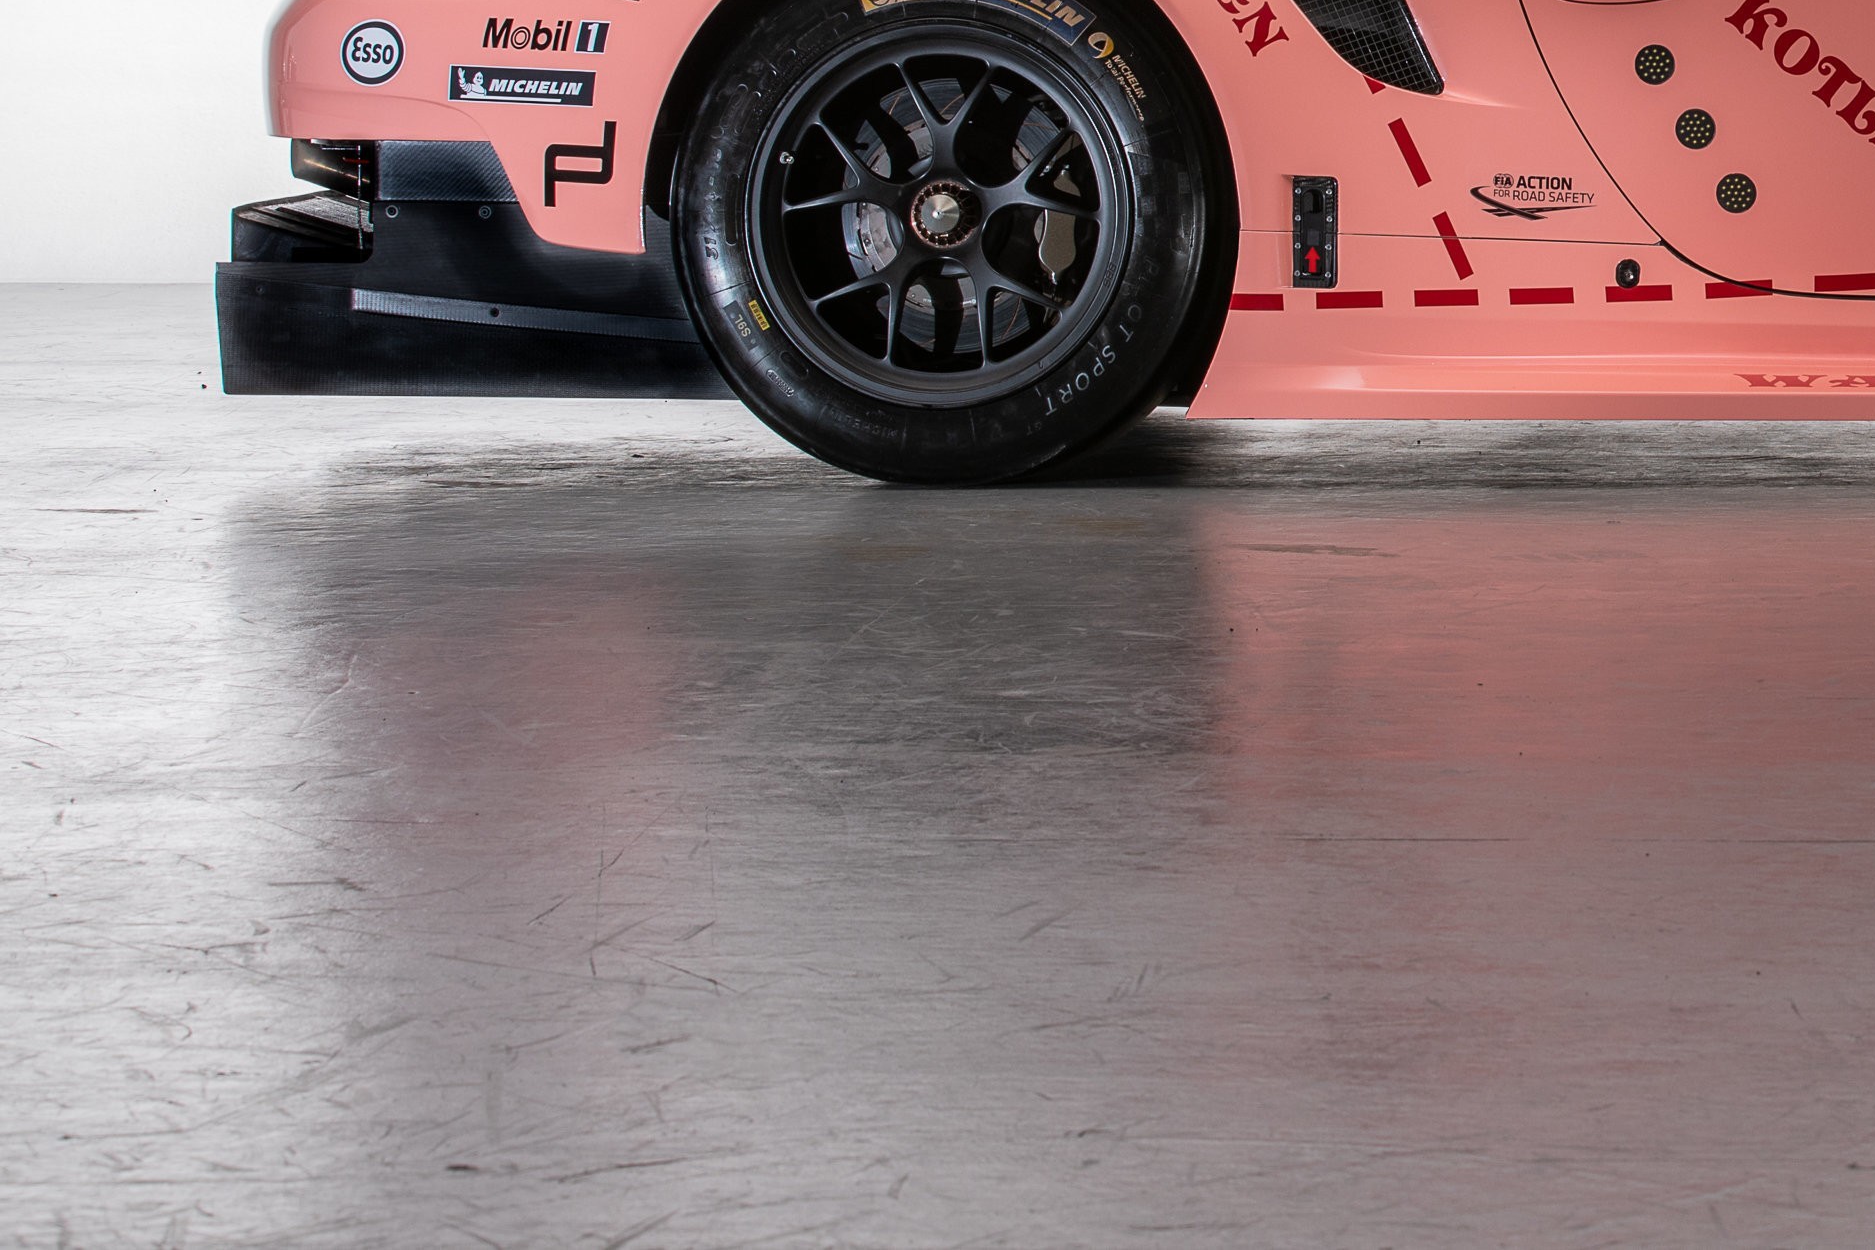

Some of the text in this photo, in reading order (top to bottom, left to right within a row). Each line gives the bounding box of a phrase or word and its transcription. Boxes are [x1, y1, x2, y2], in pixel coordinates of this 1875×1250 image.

[482, 17, 573, 52] Mobil
[488, 78, 583, 96] MICHELIN
[1111, 53, 1148, 100] MICHELIN
[1493, 188, 1595, 204] FOR ROAD SAFETY
[1515, 175, 1573, 191] ACTION
[1044, 344, 1117, 417] SPORT
